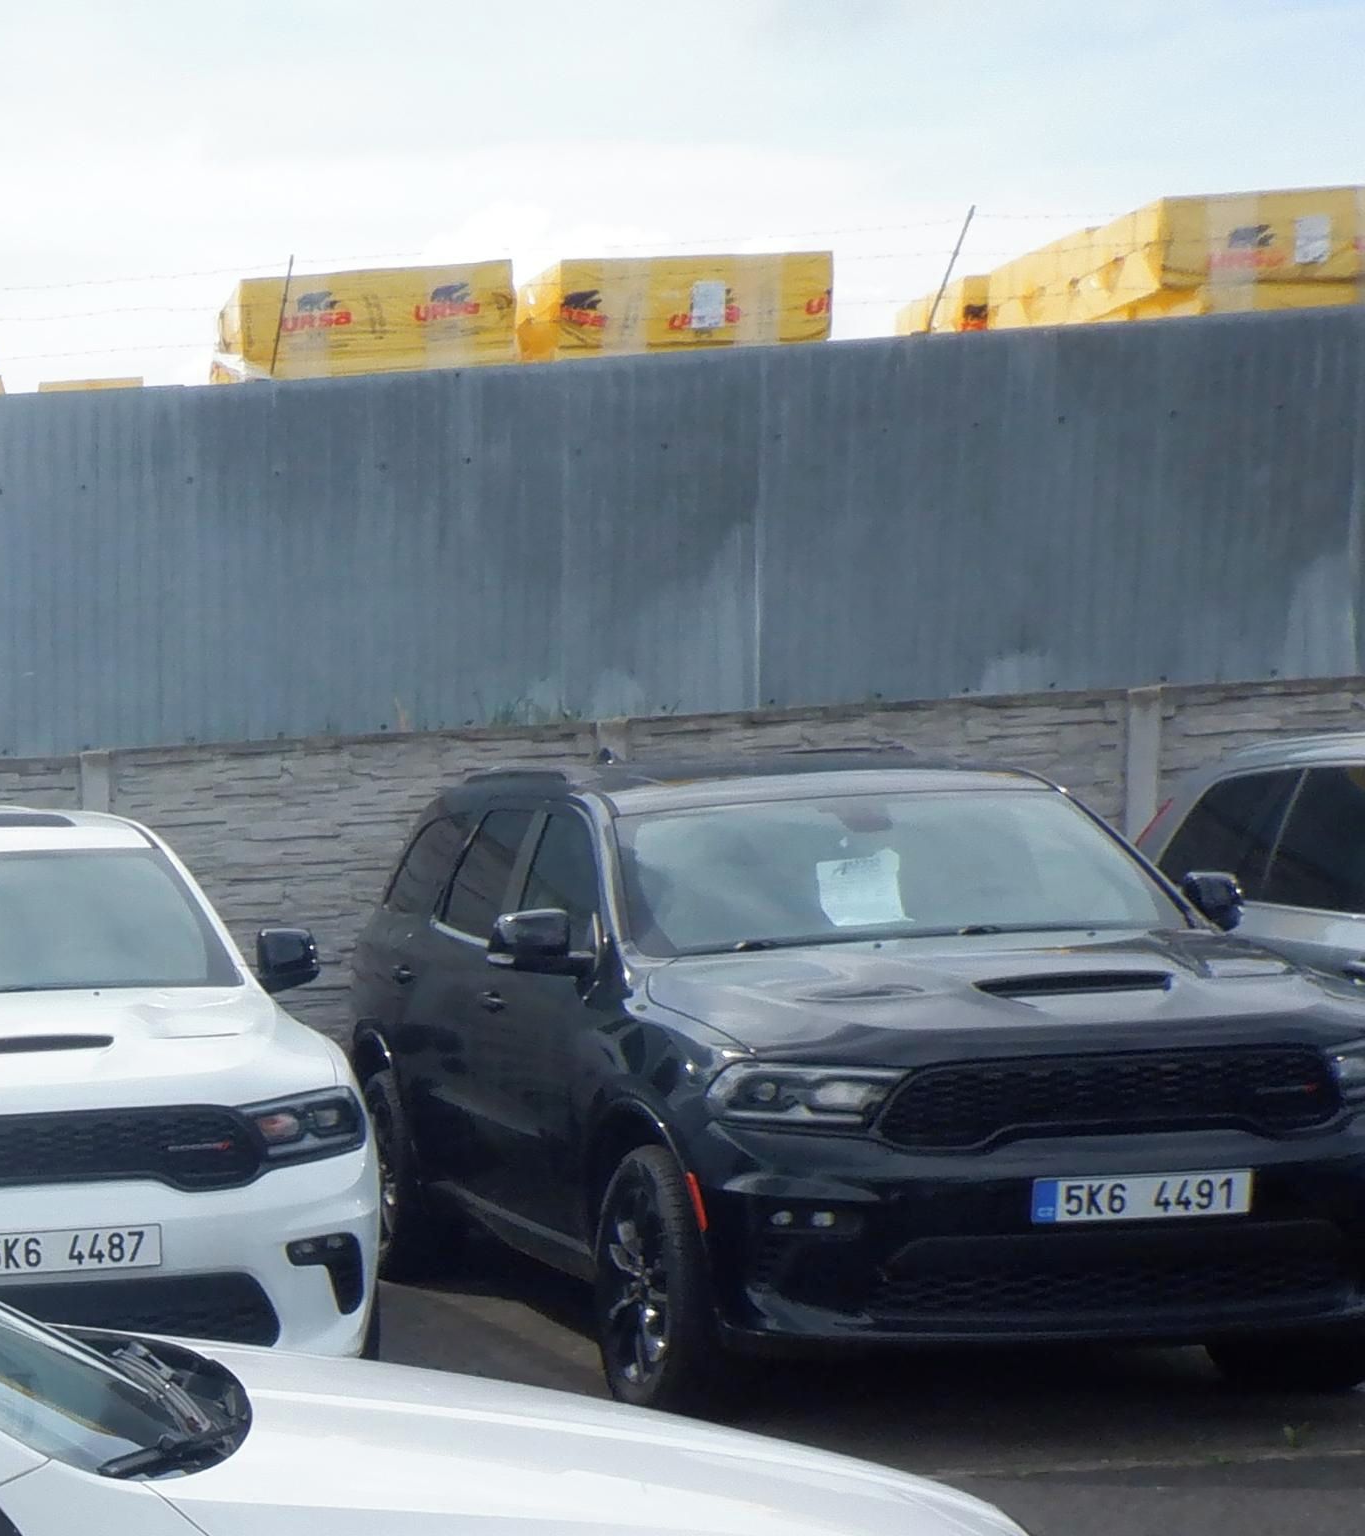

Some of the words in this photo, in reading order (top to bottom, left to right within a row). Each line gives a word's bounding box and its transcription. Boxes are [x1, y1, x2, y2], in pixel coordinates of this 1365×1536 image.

[1065, 1183, 1127, 1216] 5K6
[1154, 1177, 1234, 1213] 4491
[68, 1230, 145, 1266] 4487
